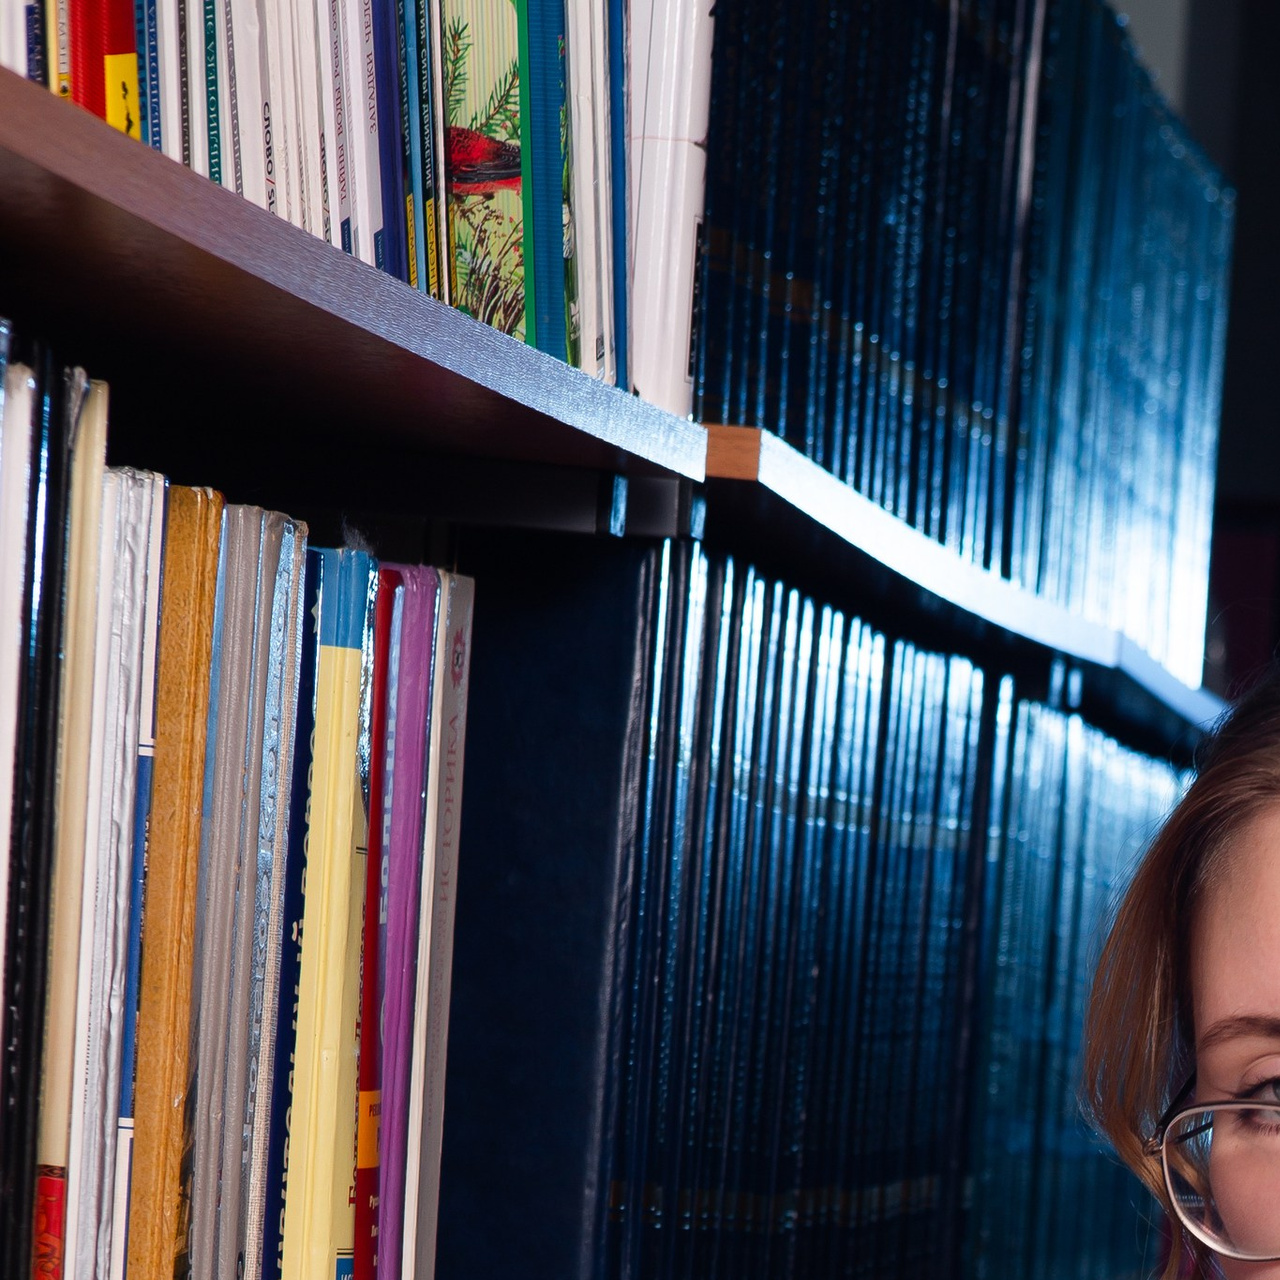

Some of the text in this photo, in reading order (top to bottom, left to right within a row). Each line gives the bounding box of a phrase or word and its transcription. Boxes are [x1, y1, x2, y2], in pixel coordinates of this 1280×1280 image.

[365, 51, 377, 134] ЗАГАДКИ
[399, 21, 410, 156] СОЕДИНЕНИЯ
[420, 48, 429, 99] СИЛЫ.
[263, 101, 273, 176] СЛОВО
[320, 132, 329, 202] СЛОВО
[338, 144, 346, 204] ТАЙНЫ
[422, 103, 433, 189] ДВИЖЕНИЕ
[407, 198, 416, 278] РОСМЭН
[427, 202, 436, 280] РОСМЭН
[260, 746, 279, 854] Кто
[439, 714, 459, 902] ИСТОРИКА
